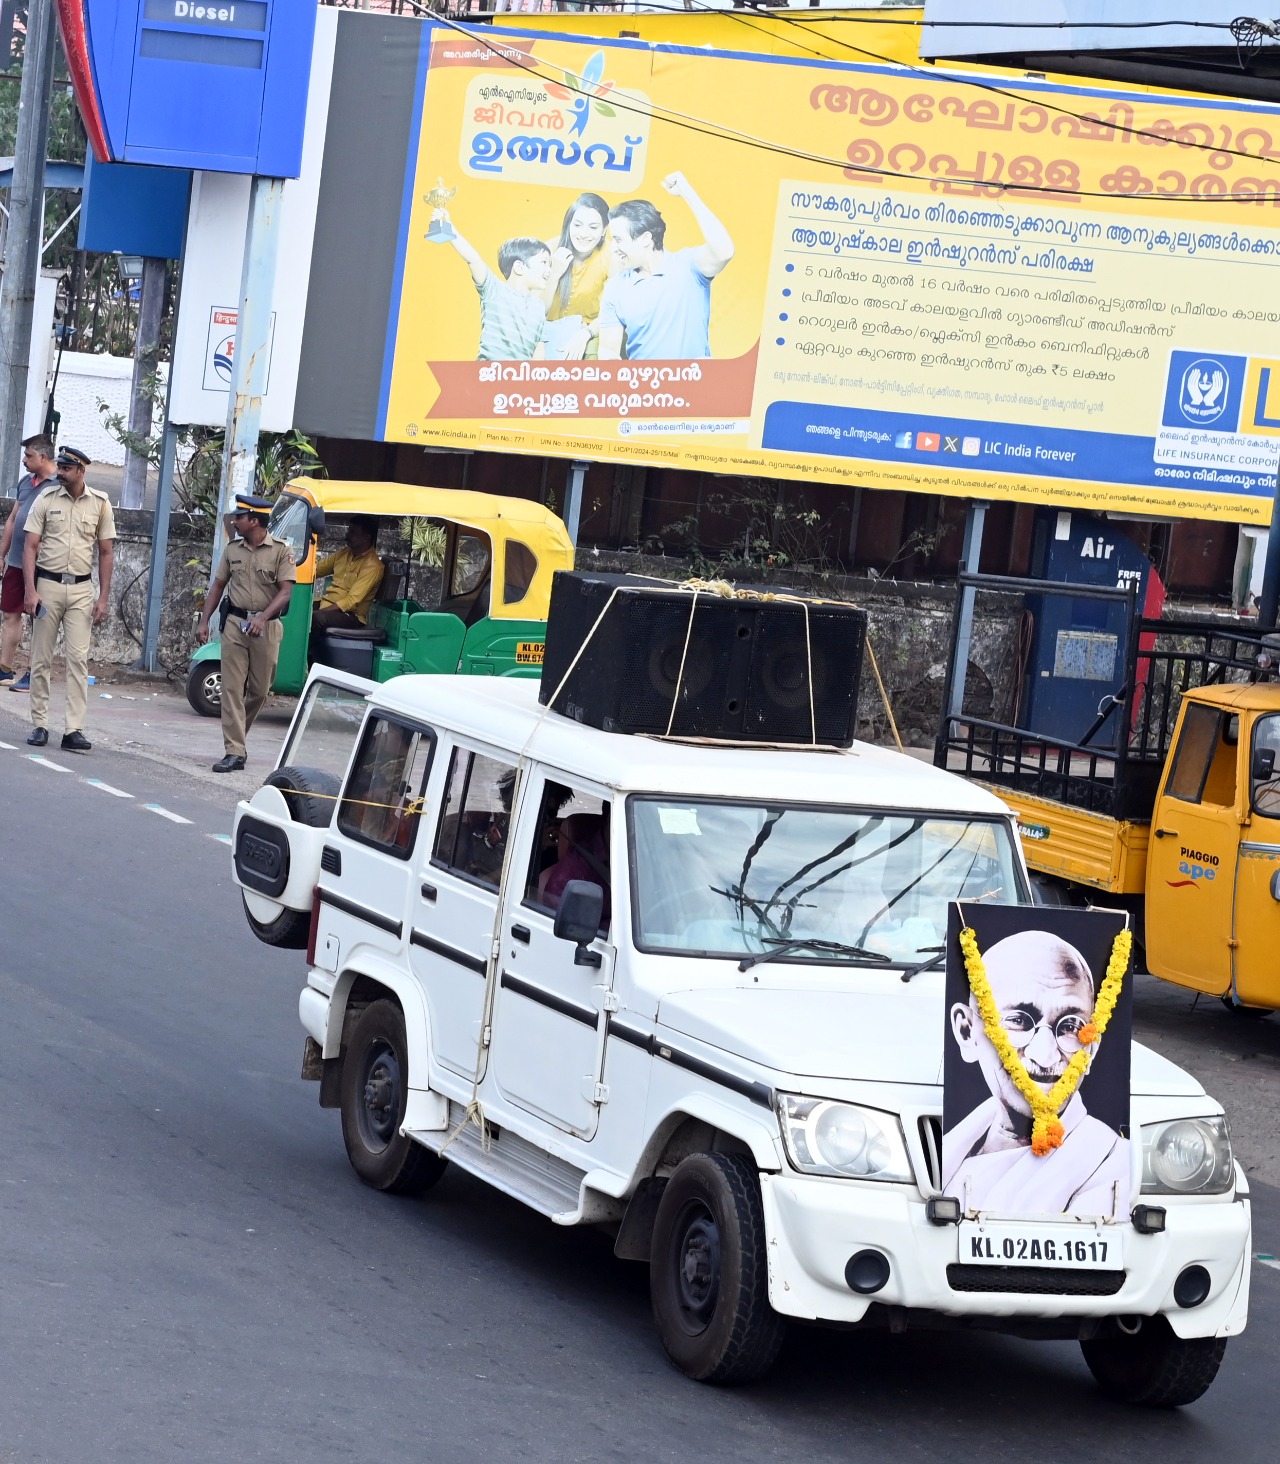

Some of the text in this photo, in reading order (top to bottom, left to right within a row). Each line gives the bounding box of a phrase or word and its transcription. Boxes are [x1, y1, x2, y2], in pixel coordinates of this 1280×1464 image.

[175, 0, 235, 21] Diesel
[478, 84, 548, 106] എൽഐസിയുടെ
[473, 102, 565, 131] ജീവൻ
[468, 131, 644, 174] ഉത്സവ്
[842, 137, 1082, 203] ഉറപ്പുള്ള
[790, 191, 921, 223] സൗകര്യപൂർവം
[924, 201, 1102, 243] തിരഞ്ഞെടുക്കാവുന്ന
[791, 227, 1094, 273] ആയുഷ്കാല ഇൻഷുറൻസ് പരിരക്ഷ
[804, 265, 814, 277] 5
[818, 266, 868, 283] വർഷം
[871, 272, 915, 289] മുതൽ
[920, 278, 937, 290] 16
[941, 279, 991, 296] വർഷം
[995, 283, 1030, 299] വരെ
[1034, 288, 1167, 313] പരിമിതപ്പെടുത്തിയ
[1170, 301, 1228, 319] പ്രീമിയം
[801, 289, 1176, 338] പ്രീമിയം അടവ് കാലയളവിൽ ഗ്യാരണ്ടീഡ് അഡീഷൻസ്
[798, 314, 858, 333] റെഗുലർ
[984, 332, 1036, 350] ഇൻകം
[1040, 338, 1150, 361] ബെനിഫിറ്റുകൾ
[795, 340, 1116, 382] ഏറ്റവും കുറഞ്ഞ ഇൻഷുറൻസ് തുക ₹5 ലക്ഷം
[477, 362, 702, 390] ജീവിതകാലം മുഴുവൻ
[492, 392, 691, 417] ഉറപ്പുള്ള വരുമാനം.
[422, 428, 477, 440] www.licindia.in
[486, 433, 500, 441] Plan
[805, 424, 841, 440] ഞങ്ങളെ
[1159, 431, 1191, 443] ലൈഫ്
[1190, 433, 1247, 446] ഇൻഷുറൻസ്
[984, 441, 1002, 455] LIC
[1004, 443, 1032, 459] India
[1034, 446, 1076, 463] Forever
[1157, 448, 1177, 458] LIFE
[1180, 450, 1236, 464] INSURANCE
[1154, 467, 1191, 479] ഓരോ
[1192, 467, 1256, 490] നിമിഷവും
[1080, 536, 1115, 560] Air
[1117, 569, 1142, 581] FREE
[522, 643, 545, 653] KL.02
[1179, 846, 1220, 866] PIAGGIO
[1178, 860, 1218, 881] ape
[970, 1235, 1108, 1263] KL.02AG.1617
